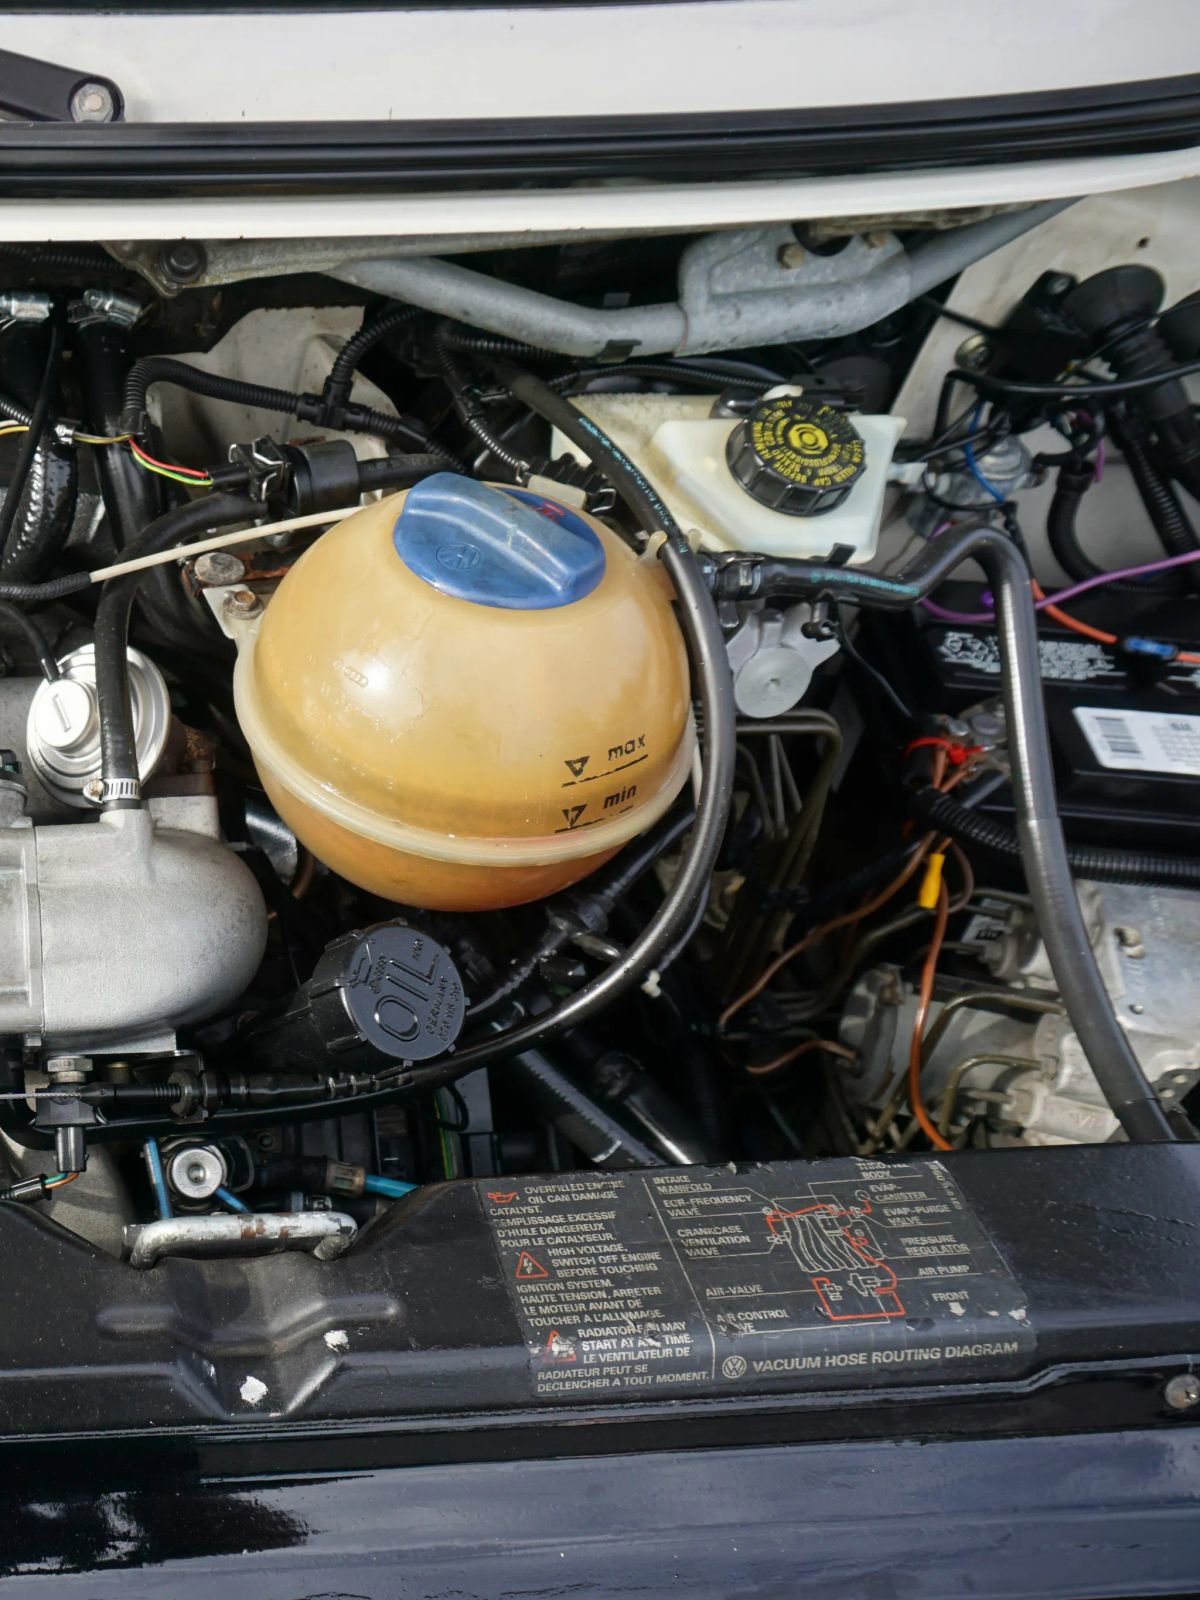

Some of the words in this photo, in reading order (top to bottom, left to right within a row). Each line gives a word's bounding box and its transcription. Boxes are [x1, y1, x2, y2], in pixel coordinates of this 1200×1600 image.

[773, 461, 807, 483] BEFORE
[813, 477, 831, 486] CAP
[608, 733, 646, 761] max
[603, 785, 637, 810] min
[374, 954, 441, 1042] OIL
[652, 1175, 691, 1185] INTAKE
[524, 1184, 585, 1194] OVERFILLED
[657, 1183, 713, 1194] MANIFOLD
[528, 1196, 546, 1204] OIL
[548, 1194, 570, 1203] CAN
[572, 1191, 618, 1201] DAMAGE
[490, 1205, 543, 1216] CATALYST.
[568, 1211, 618, 1222] EXCESSIF
[667, 1208, 701, 1217] VALVE
[888, 1216, 922, 1226] VALVE
[497, 1228, 538, 1238] D'HUILE
[540, 1223, 606, 1235] DANGEREUX
[677, 1225, 743, 1237] CRANKCASE
[501, 1238, 531, 1248] POUR
[533, 1237, 545, 1246] LE
[546, 1233, 616, 1245] CATALYSEUR.
[680, 1235, 751, 1247] VENTILATION
[901, 1234, 957, 1246] PRESSURE
[547, 1247, 575, 1256] HIGH
[686, 1247, 720, 1257] VALVE
[906, 1244, 970, 1256] REGULATOR
[552, 1257, 596, 1267] SWITCH
[599, 1255, 618, 1264] OFF
[622, 1252, 662, 1262] ENGINE
[556, 1268, 599, 1278] BEFORE
[601, 1263, 658, 1274] TOUCHING
[918, 1267, 937, 1276] AIR
[939, 1265, 970, 1275] PUMP
[516, 1283, 565, 1294] IGNITION
[567, 1279, 614, 1290] SYSTEM.
[706, 1284, 764, 1297] AIR-VALVE
[520, 1294, 556, 1304] HAUTE
[613, 1287, 662, 1297] ARRETER
[932, 1291, 970, 1302] FRONT
[524, 1307, 537, 1316] LE
[539, 1303, 586, 1314] MOTEUR
[589, 1301, 625, 1311] AVANT
[628, 1299, 643, 1309] DE
[528, 1315, 581, 1327] TOUCHER
[584, 1313, 593, 1322] A
[738, 1309, 790, 1321] CONTROL
[663, 1322, 686, 1332] MAY
[581, 1340, 617, 1351] START
[621, 1338, 634, 1348] AT
[664, 1334, 694, 1345] TIME.
[583, 1354, 596, 1364] LE
[599, 1348, 673, 1362] VENTILATEUR
[676, 1347, 690, 1357] DE
[752, 1356, 820, 1372] VACUUM
[825, 1353, 868, 1367] HOSE
[872, 1348, 941, 1364] ROUTING
[945, 1342, 1019, 1358] DIAGRAM
[537, 1368, 600, 1381] RADIATEUR
[603, 1365, 631, 1376] PEUT
[634, 1364, 649, 1374] SE
[537, 1379, 610, 1392] DECLENCHER
[612, 1377, 621, 1386] A
[624, 1375, 653, 1386] TOUT
[656, 1371, 710, 1384] MOMENT.
